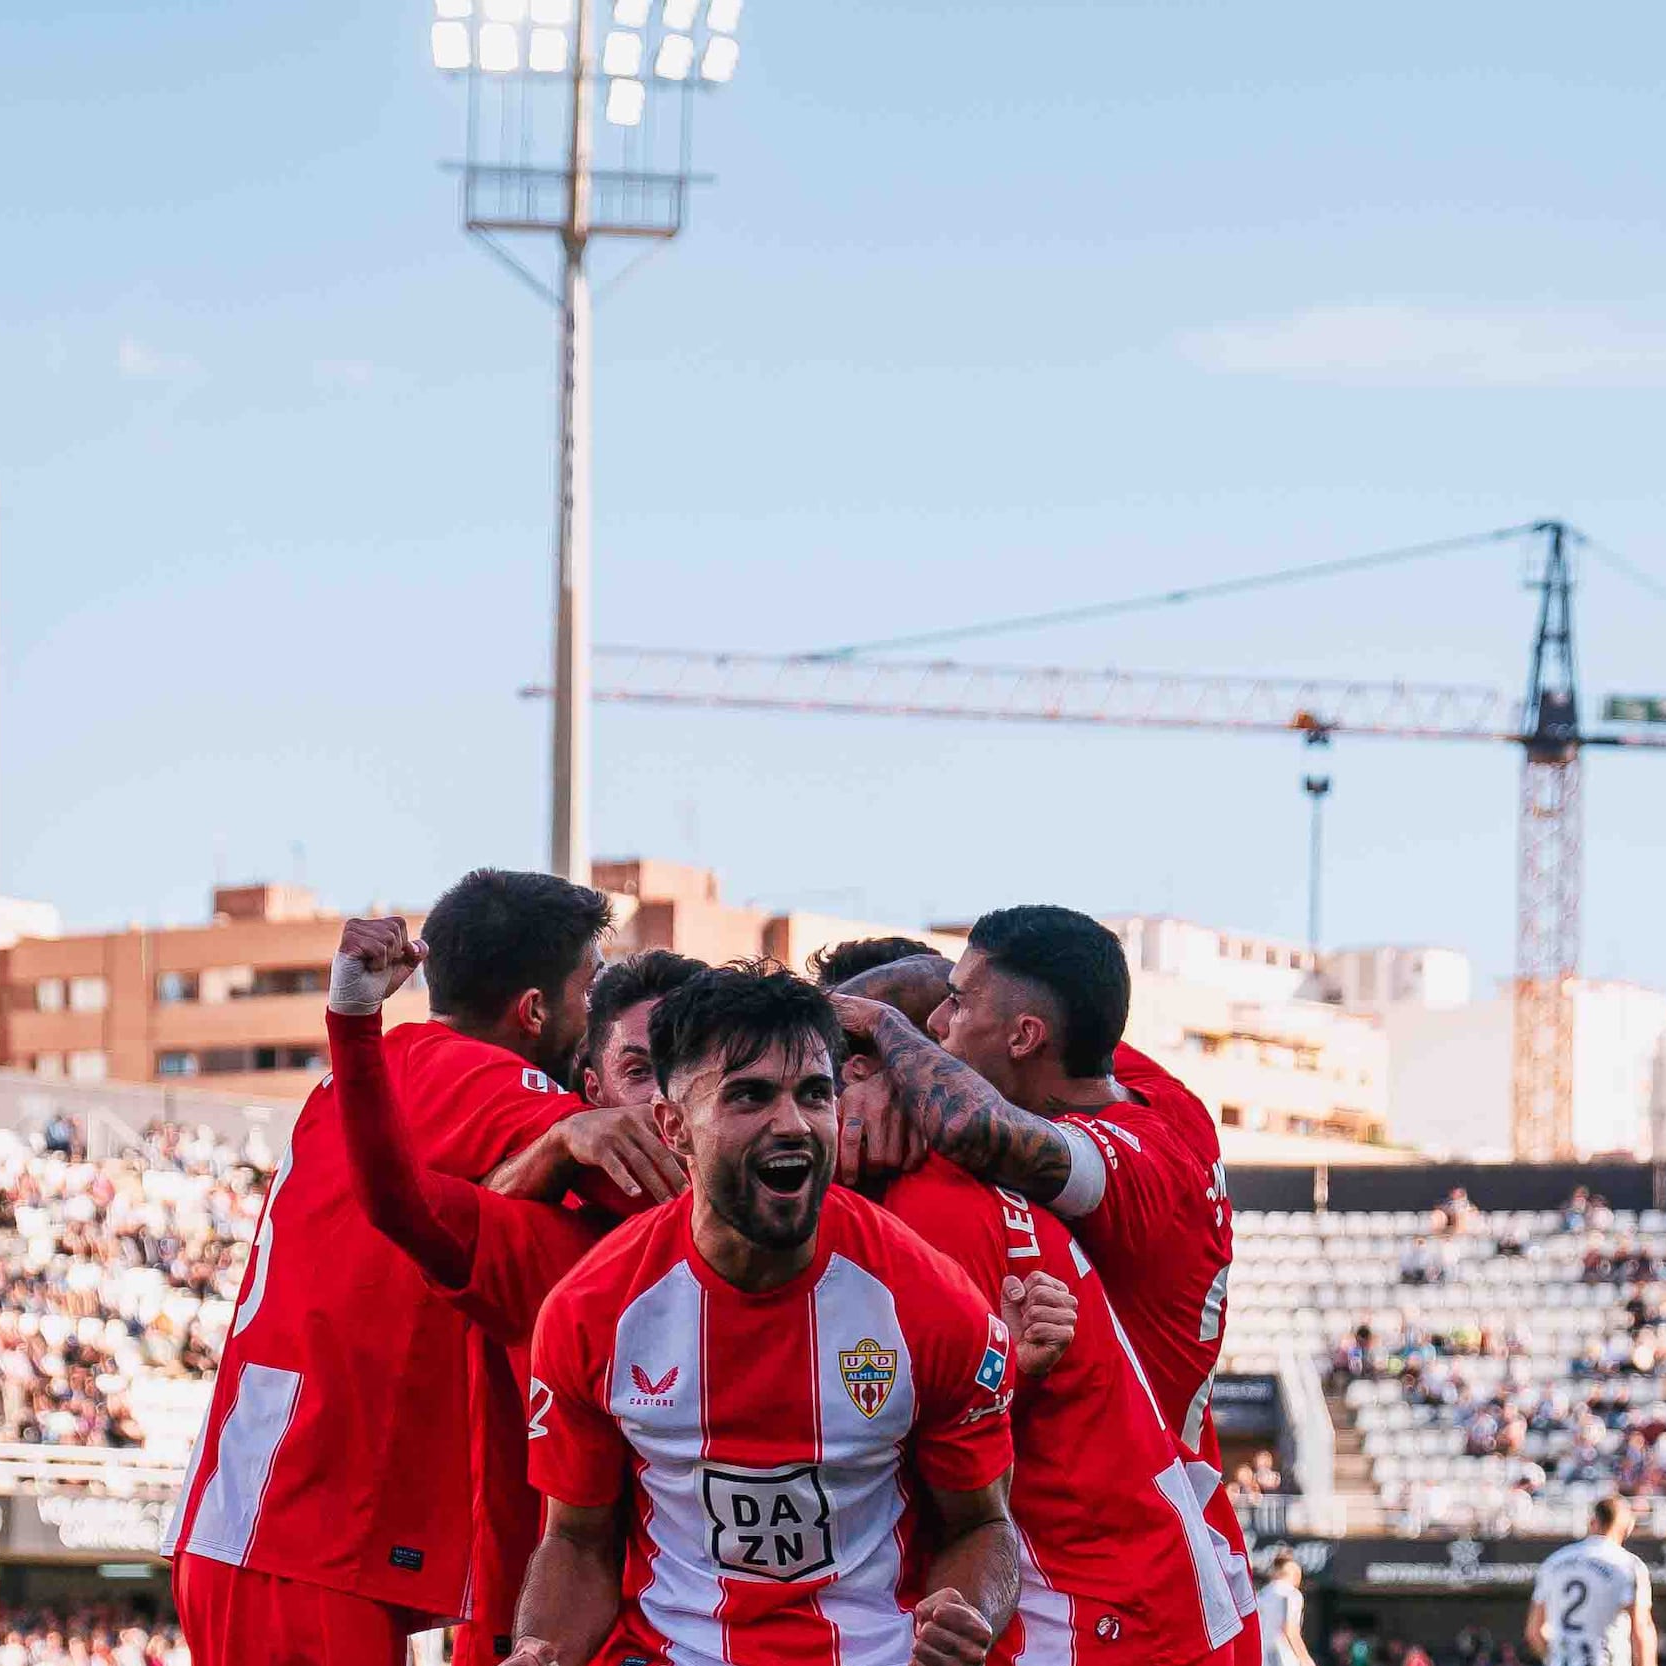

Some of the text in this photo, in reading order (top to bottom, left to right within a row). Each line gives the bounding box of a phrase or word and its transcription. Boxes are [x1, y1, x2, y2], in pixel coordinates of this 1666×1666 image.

[847, 1371, 890, 1380] ALMERIA
[629, 1397, 675, 1407] CASTORE
[732, 1494, 803, 1527] DA
[738, 1532, 804, 1566] ZN
[1562, 1579, 1587, 1632] 2
